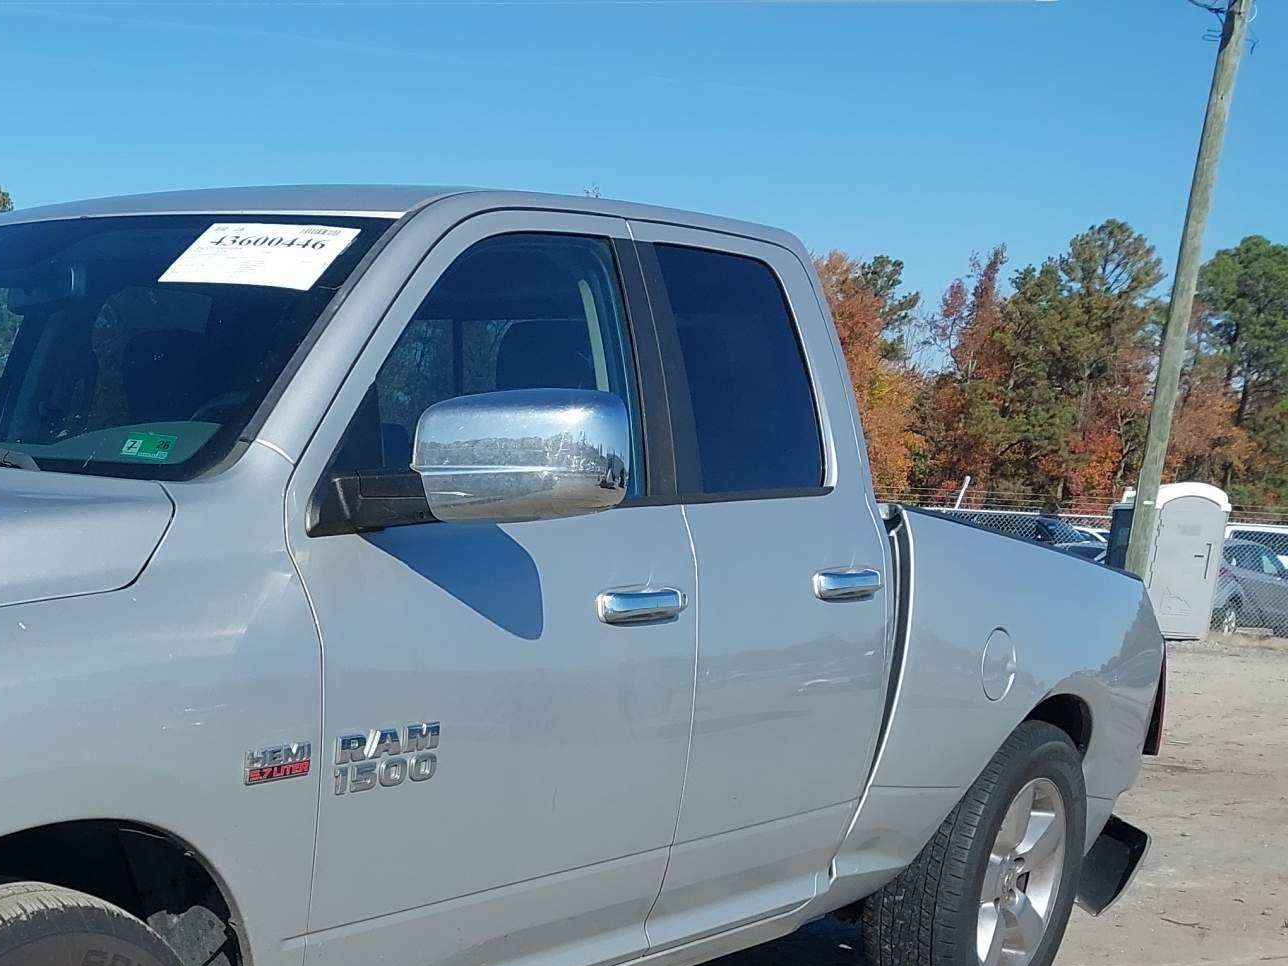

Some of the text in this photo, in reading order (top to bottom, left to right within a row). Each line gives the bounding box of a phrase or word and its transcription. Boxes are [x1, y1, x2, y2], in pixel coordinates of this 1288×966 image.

[210, 235, 327, 250] 43600446
[245, 743, 311, 768] HEMI
[334, 721, 440, 765] RAM
[334, 752, 438, 796] 1500
